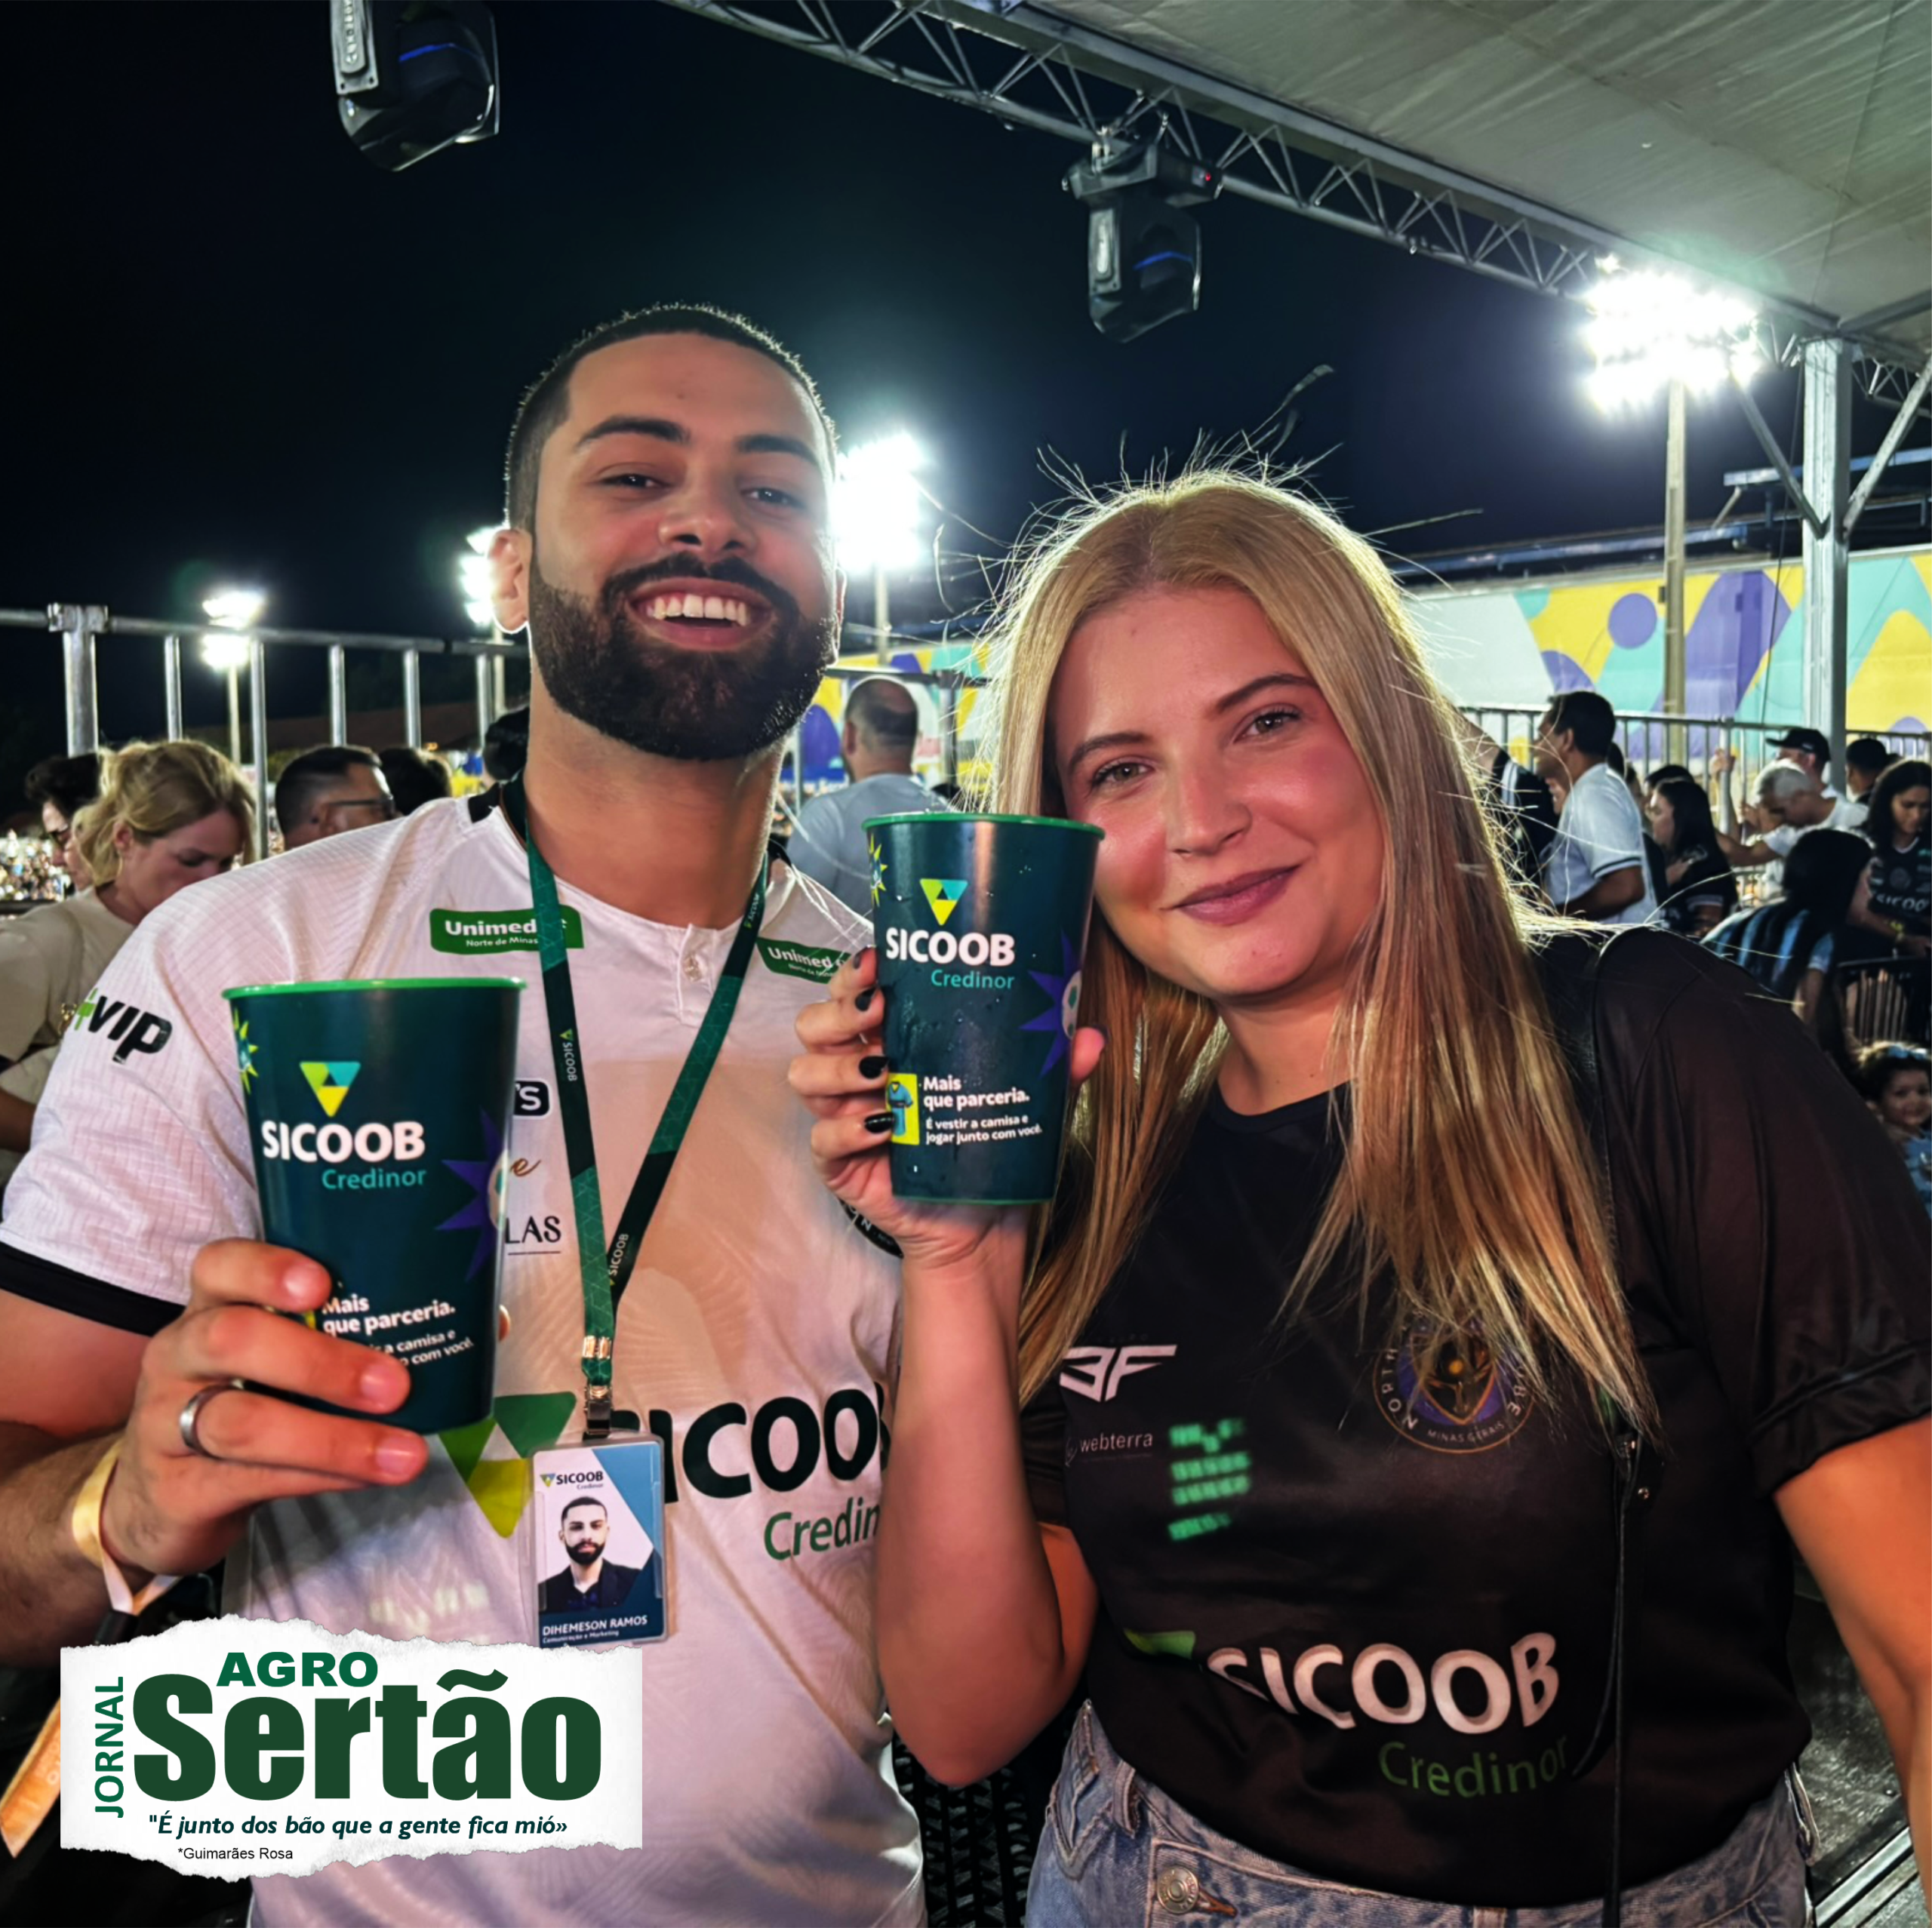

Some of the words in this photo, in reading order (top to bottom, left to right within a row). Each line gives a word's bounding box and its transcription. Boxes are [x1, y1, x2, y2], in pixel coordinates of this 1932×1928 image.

[445, 918, 537, 936] Unimed
[509, 936, 538, 945] Minas
[886, 927, 1015, 967] SICOOB
[768, 946, 832, 969] Unimed
[931, 970, 1014, 989] Credinor
[562, 1041, 577, 1081] SICOOB
[923, 1075, 961, 1092] Mais
[923, 1096, 953, 1112] que
[956, 1087, 1030, 1112] parceria.
[926, 1117, 933, 1130] É
[935, 1118, 968, 1130] vestir
[971, 1119, 978, 1129] a
[980, 1115, 1020, 1128] camisa
[1021, 1115, 1029, 1124] e
[261, 1120, 426, 1163] SICOOB
[926, 1132, 955, 1145] jogar
[956, 1130, 989, 1145] junto
[992, 1129, 1017, 1140] com
[322, 1167, 426, 1190] Credinor
[608, 1232, 629, 1276] SICOOB
[321, 1293, 370, 1315] Mais
[323, 1318, 361, 1337] que
[365, 1299, 455, 1336] parceria.
[396, 1333, 445, 1352] camisa
[448, 1330, 456, 1339] e
[411, 1349, 441, 1364] com
[1079, 1433, 1154, 1453] webterra
[1428, 1429, 1465, 1443] MINAS
[1466, 1421, 1505, 1442] GERAIS
[556, 1471, 604, 1485] SICOOB
[764, 1496, 881, 1561] Credin
[542, 1620, 607, 1636] DIHEMESON
[610, 1615, 648, 1628] RAMOS
[1208, 1632, 1560, 1734] SICOOB
[1378, 1736, 1567, 1797] Credinor
